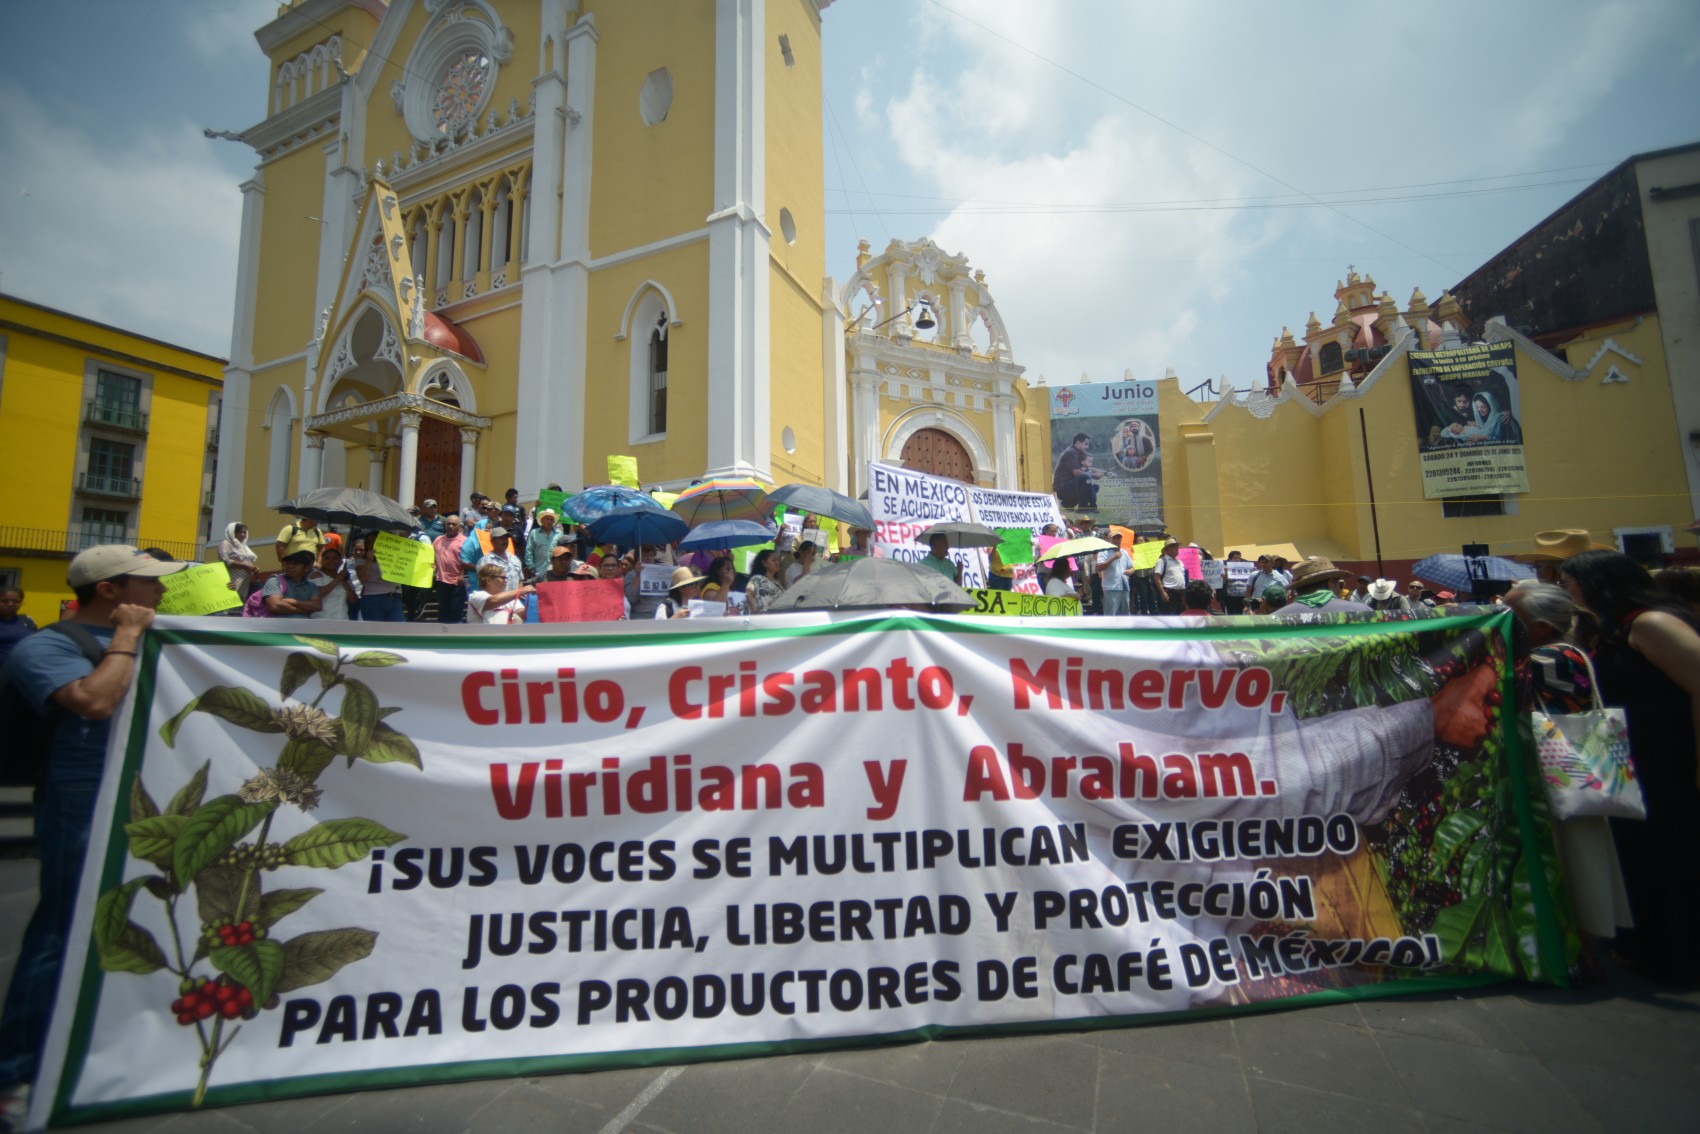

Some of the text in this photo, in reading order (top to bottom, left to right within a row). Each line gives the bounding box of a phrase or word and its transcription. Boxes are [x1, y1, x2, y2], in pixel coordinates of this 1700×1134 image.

[1101, 384, 1154, 400] Junio
[874, 470, 966, 506] EN MÉXICO
[883, 496, 962, 522] SE AGUDIZA LA
[984, 492, 1016, 508] DEMONIOS
[1018, 496, 1032, 510] QUE
[978, 510, 1054, 524] DESTRUYENDO A LOS
[461, 657, 1288, 729] Cirio, Crisanto, Minervo,
[489, 742, 1276, 821] Viridiana y Abraham.
[368, 814, 1356, 894] ¡SUS VOCES SE MULTIPLICAN EXIGIENDO
[462, 870, 1316, 970] JUSTICIA, LIBERTAD Y PROTECCIÓN
[278, 932, 1440, 1048] PARA LOS PRODUCTORES DE CAFÉ DE MÉXICO!
